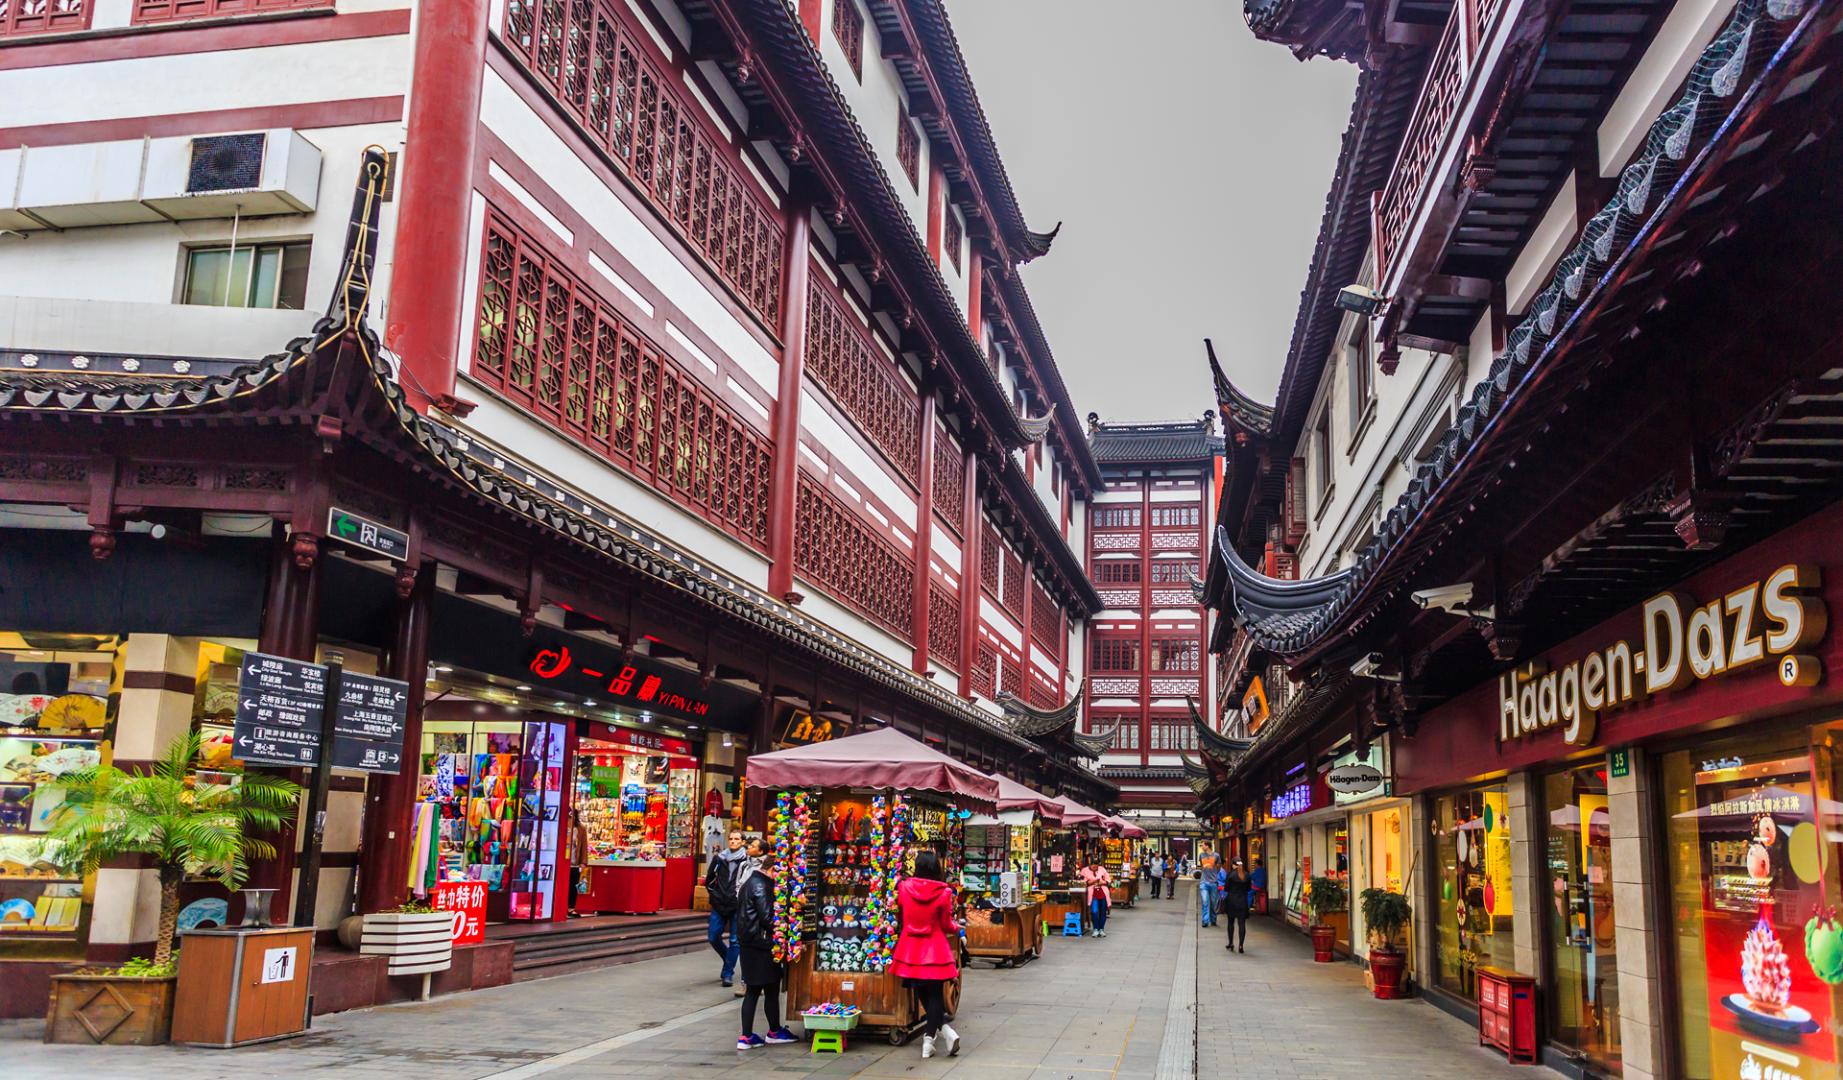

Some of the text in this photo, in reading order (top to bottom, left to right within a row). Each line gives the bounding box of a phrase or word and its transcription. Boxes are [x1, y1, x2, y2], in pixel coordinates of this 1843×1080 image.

[262, 660, 284, 671] 城隍庙
[254, 742, 276, 752] 湖心亭
[1615, 752, 1624, 767] 35
[1330, 774, 1380, 785] Häagen-Dazs
[437, 885, 485, 909] 丝巾特价
[451, 911, 479, 940] 0元
